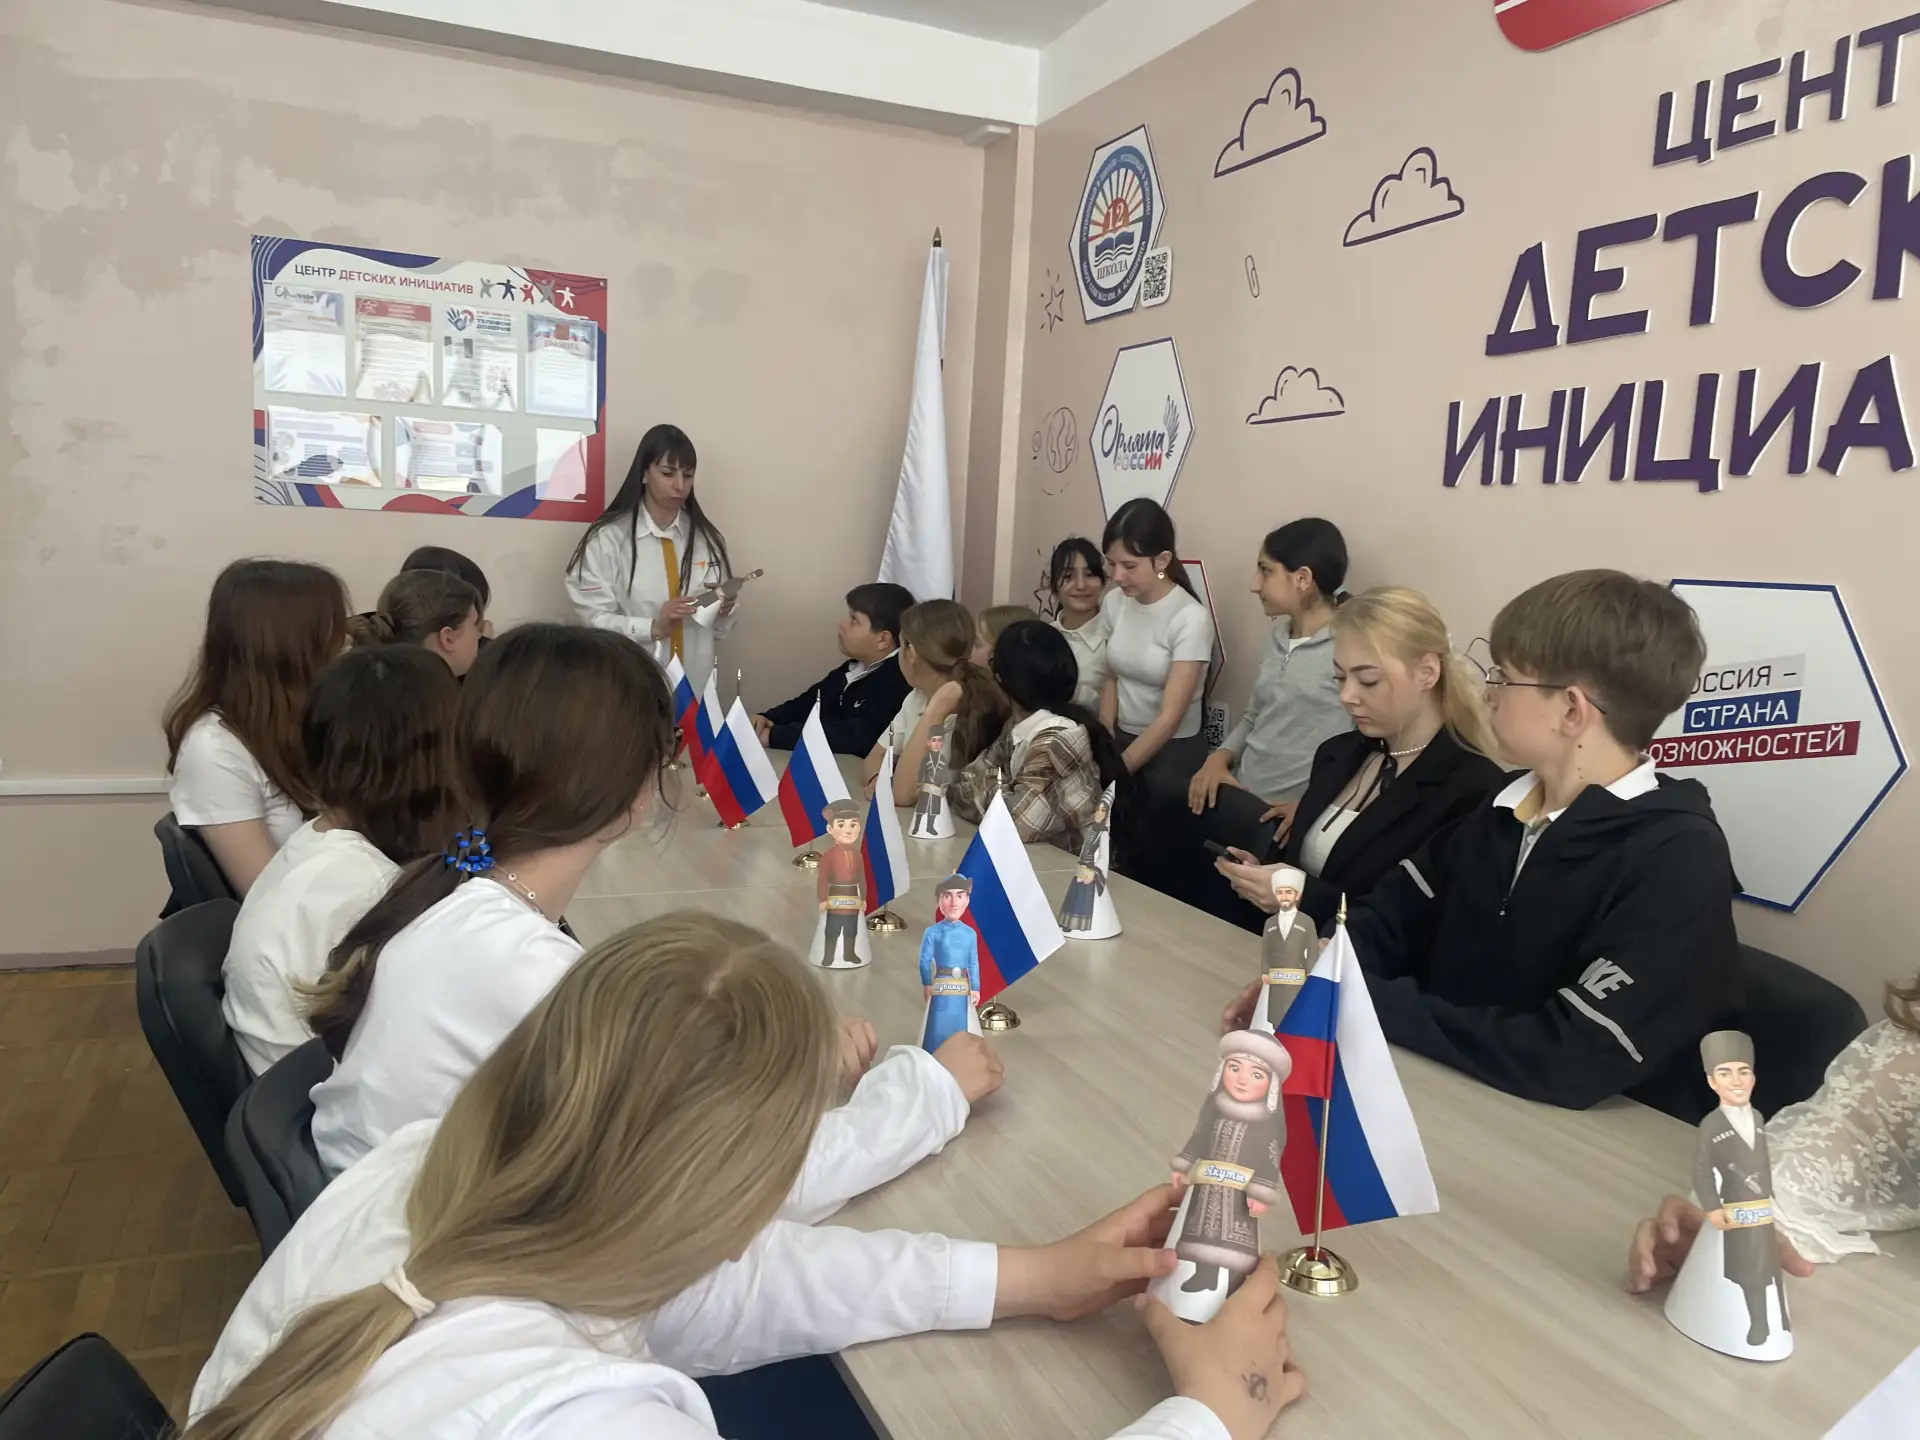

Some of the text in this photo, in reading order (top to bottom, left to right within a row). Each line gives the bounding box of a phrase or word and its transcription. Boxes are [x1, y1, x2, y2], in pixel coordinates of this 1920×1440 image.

[1653, 13, 1920, 166] ЦЕНТ
[1106, 202, 1125, 232] 12
[294, 264, 474, 295] ЦЕНТР ДЕТСКИХ ИНИЦИАТИВ
[1096, 259, 1129, 280] ШКОЛА
[1101, 404, 1165, 464] Орлята
[1443, 355, 1918, 493] ИНИЦИА
[1113, 451, 1163, 471] РОССИИ
[1690, 699, 1789, 728] СТРАНА
[1648, 724, 1846, 763] ОЗМОЖНОСТЕЙ
[1203, 1165, 1246, 1183] Якуты
